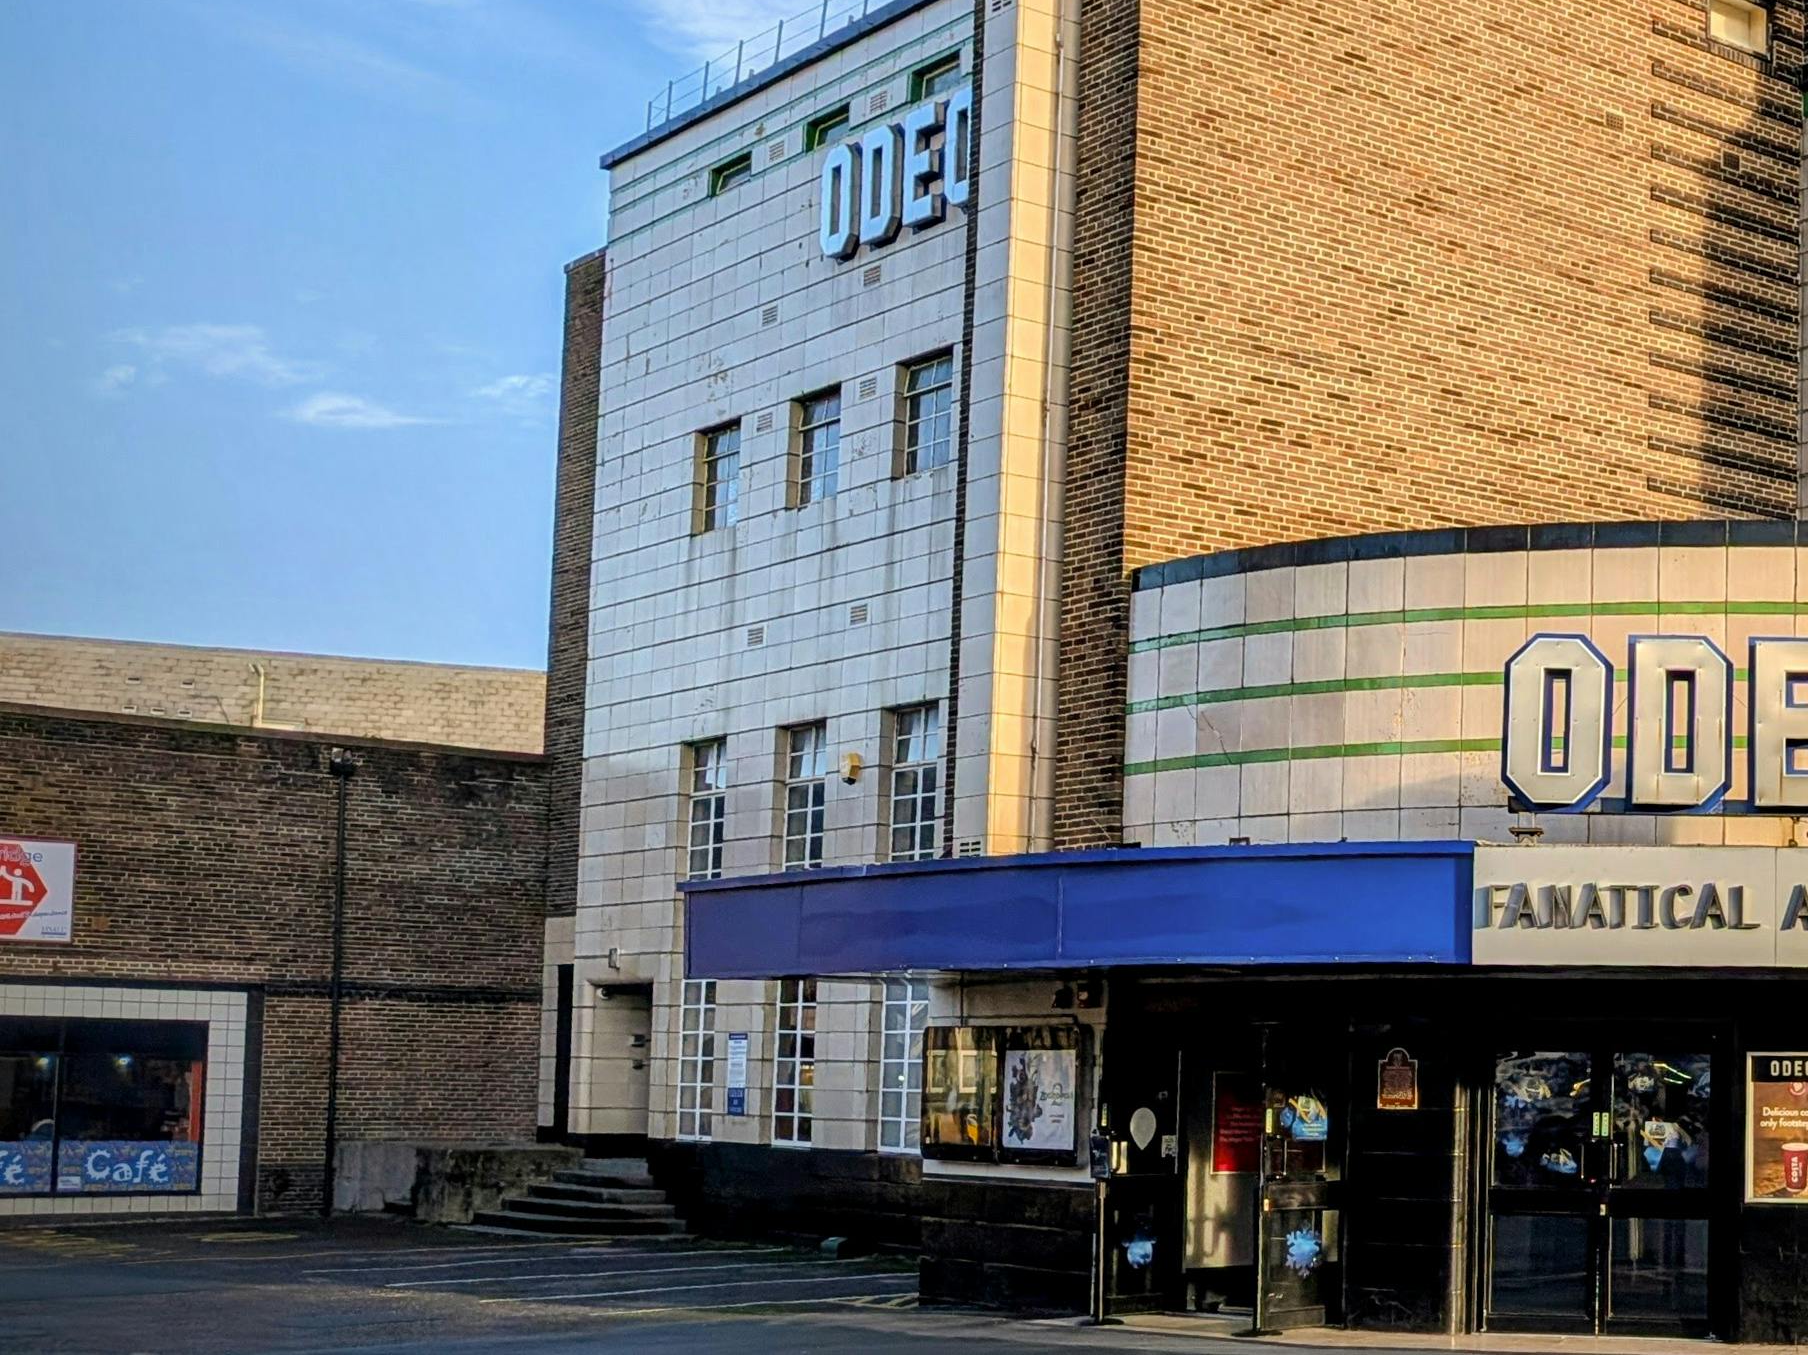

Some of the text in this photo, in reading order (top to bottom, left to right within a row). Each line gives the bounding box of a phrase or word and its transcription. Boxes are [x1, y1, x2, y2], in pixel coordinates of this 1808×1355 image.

[1474, 880, 1761, 931] FANATICAL
[1762, 1106, 1799, 1117] Delicious
[1760, 1118, 1777, 1131] only
[84, 1149, 169, 1184] Café
